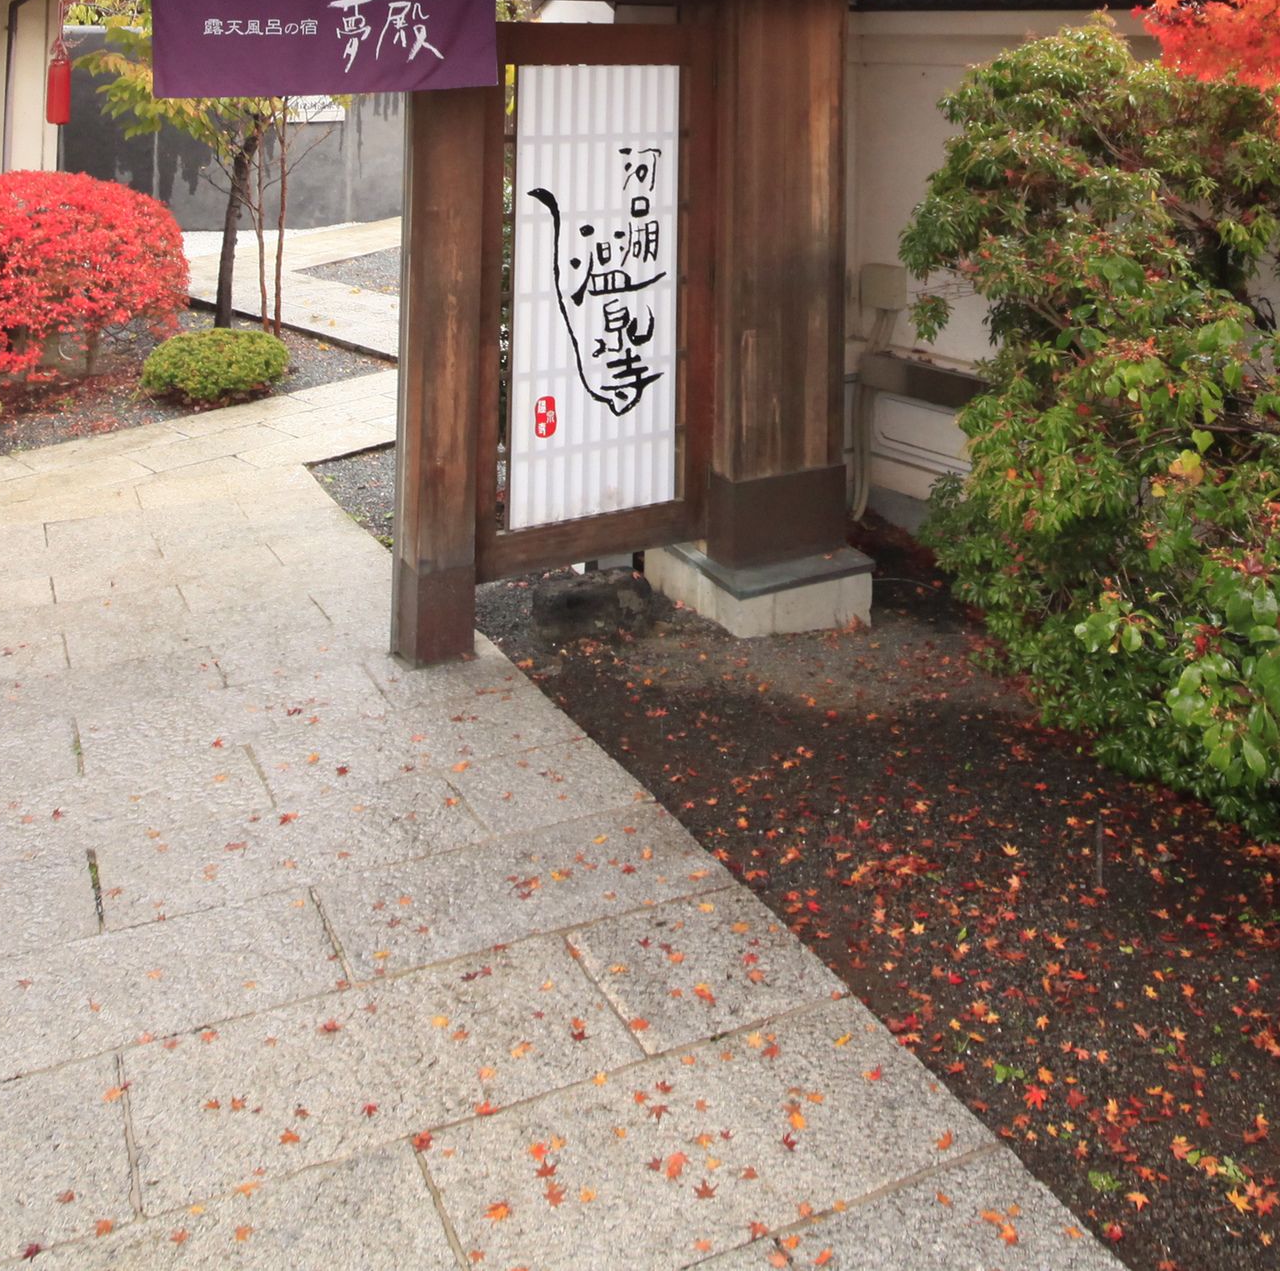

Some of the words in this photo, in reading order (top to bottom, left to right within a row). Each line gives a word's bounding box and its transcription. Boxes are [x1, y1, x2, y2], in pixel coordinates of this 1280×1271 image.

[203, 18, 318, 36] 露天風呂の宿
